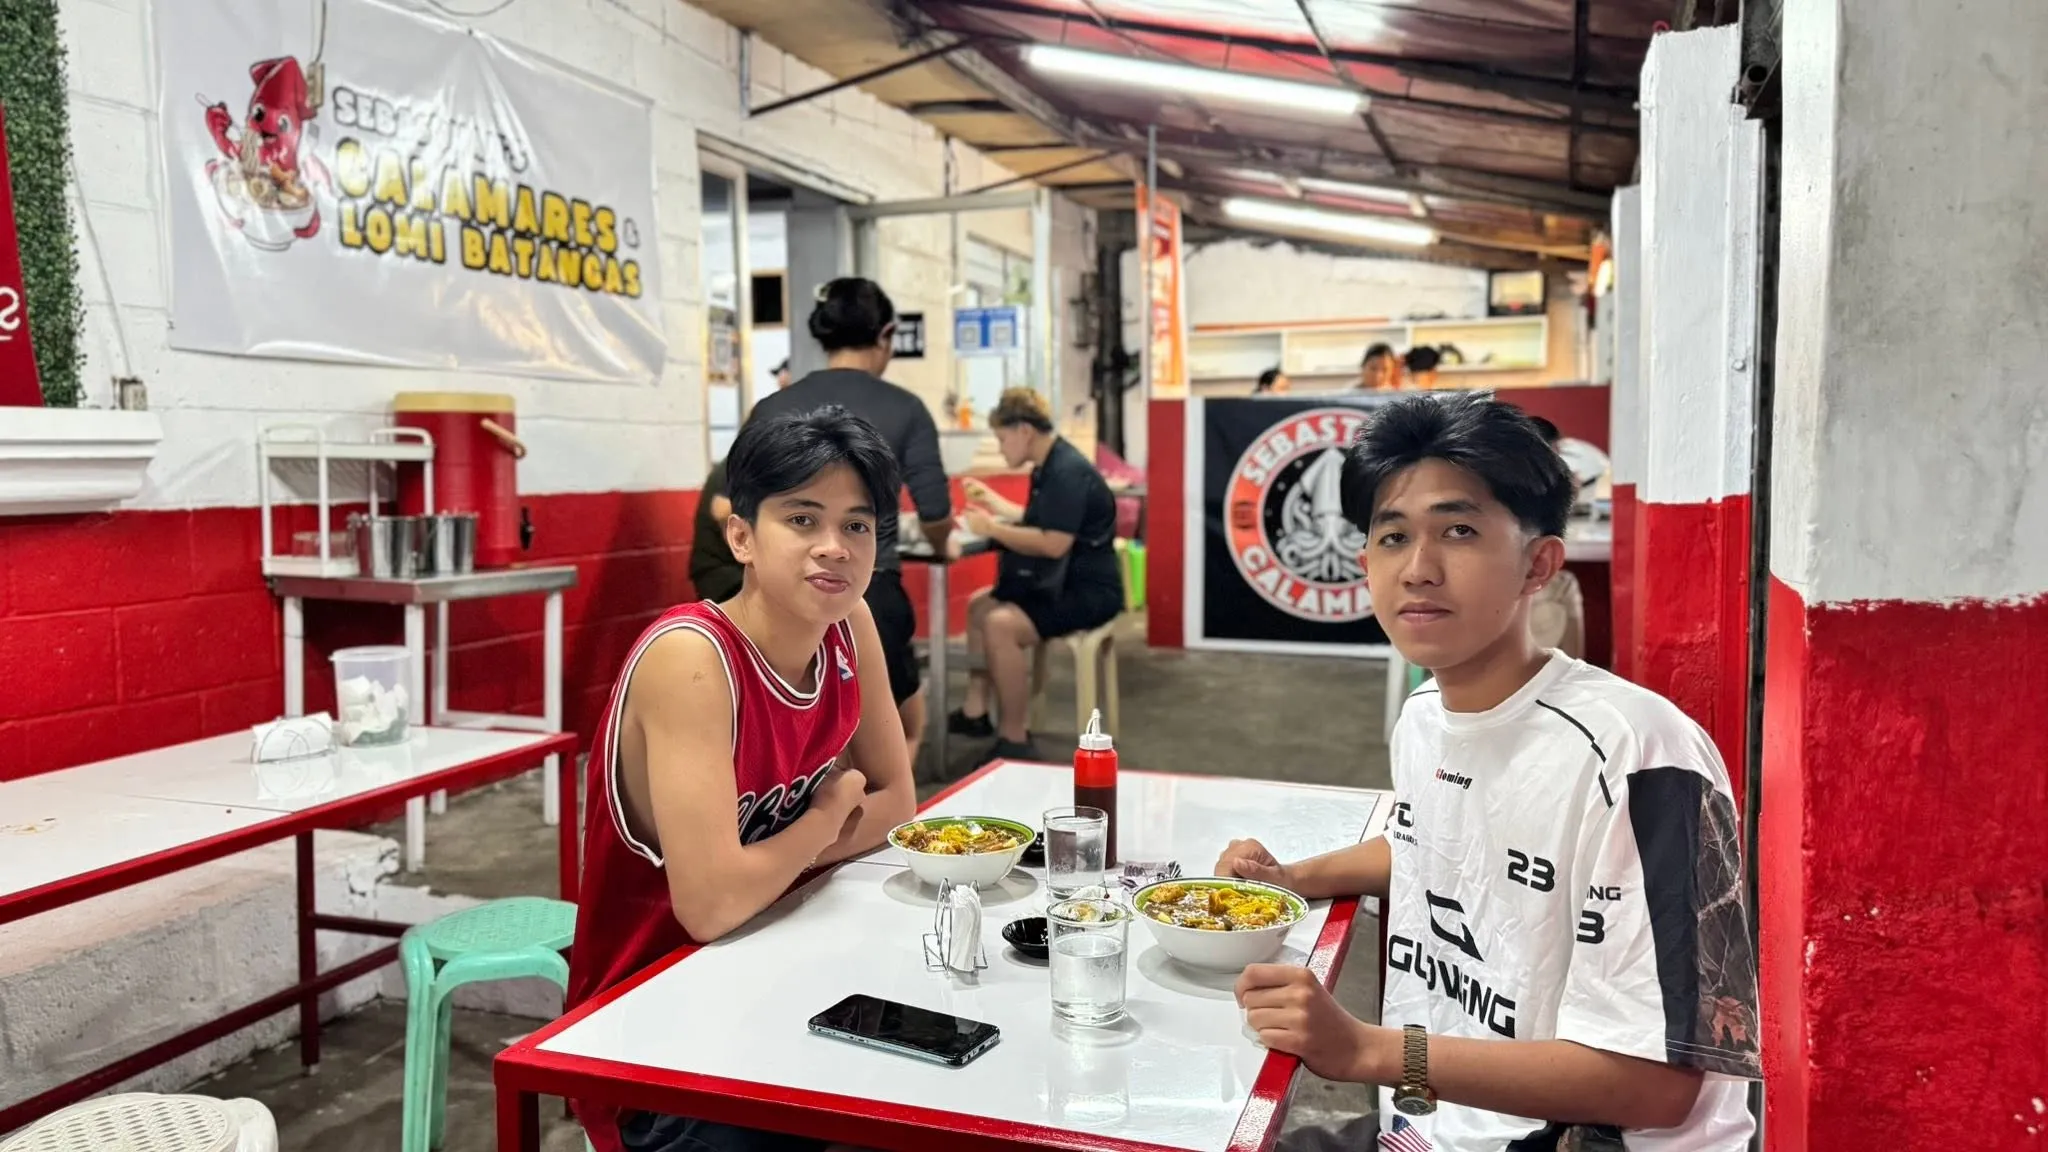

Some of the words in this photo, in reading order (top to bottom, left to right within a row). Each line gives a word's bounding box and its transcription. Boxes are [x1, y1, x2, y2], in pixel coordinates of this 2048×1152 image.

[336, 137, 617, 253] CALAMARES
[339, 197, 445, 263] LOMI
[461, 225, 642, 299] BATANGAS
[1507, 848, 1555, 893] 23
